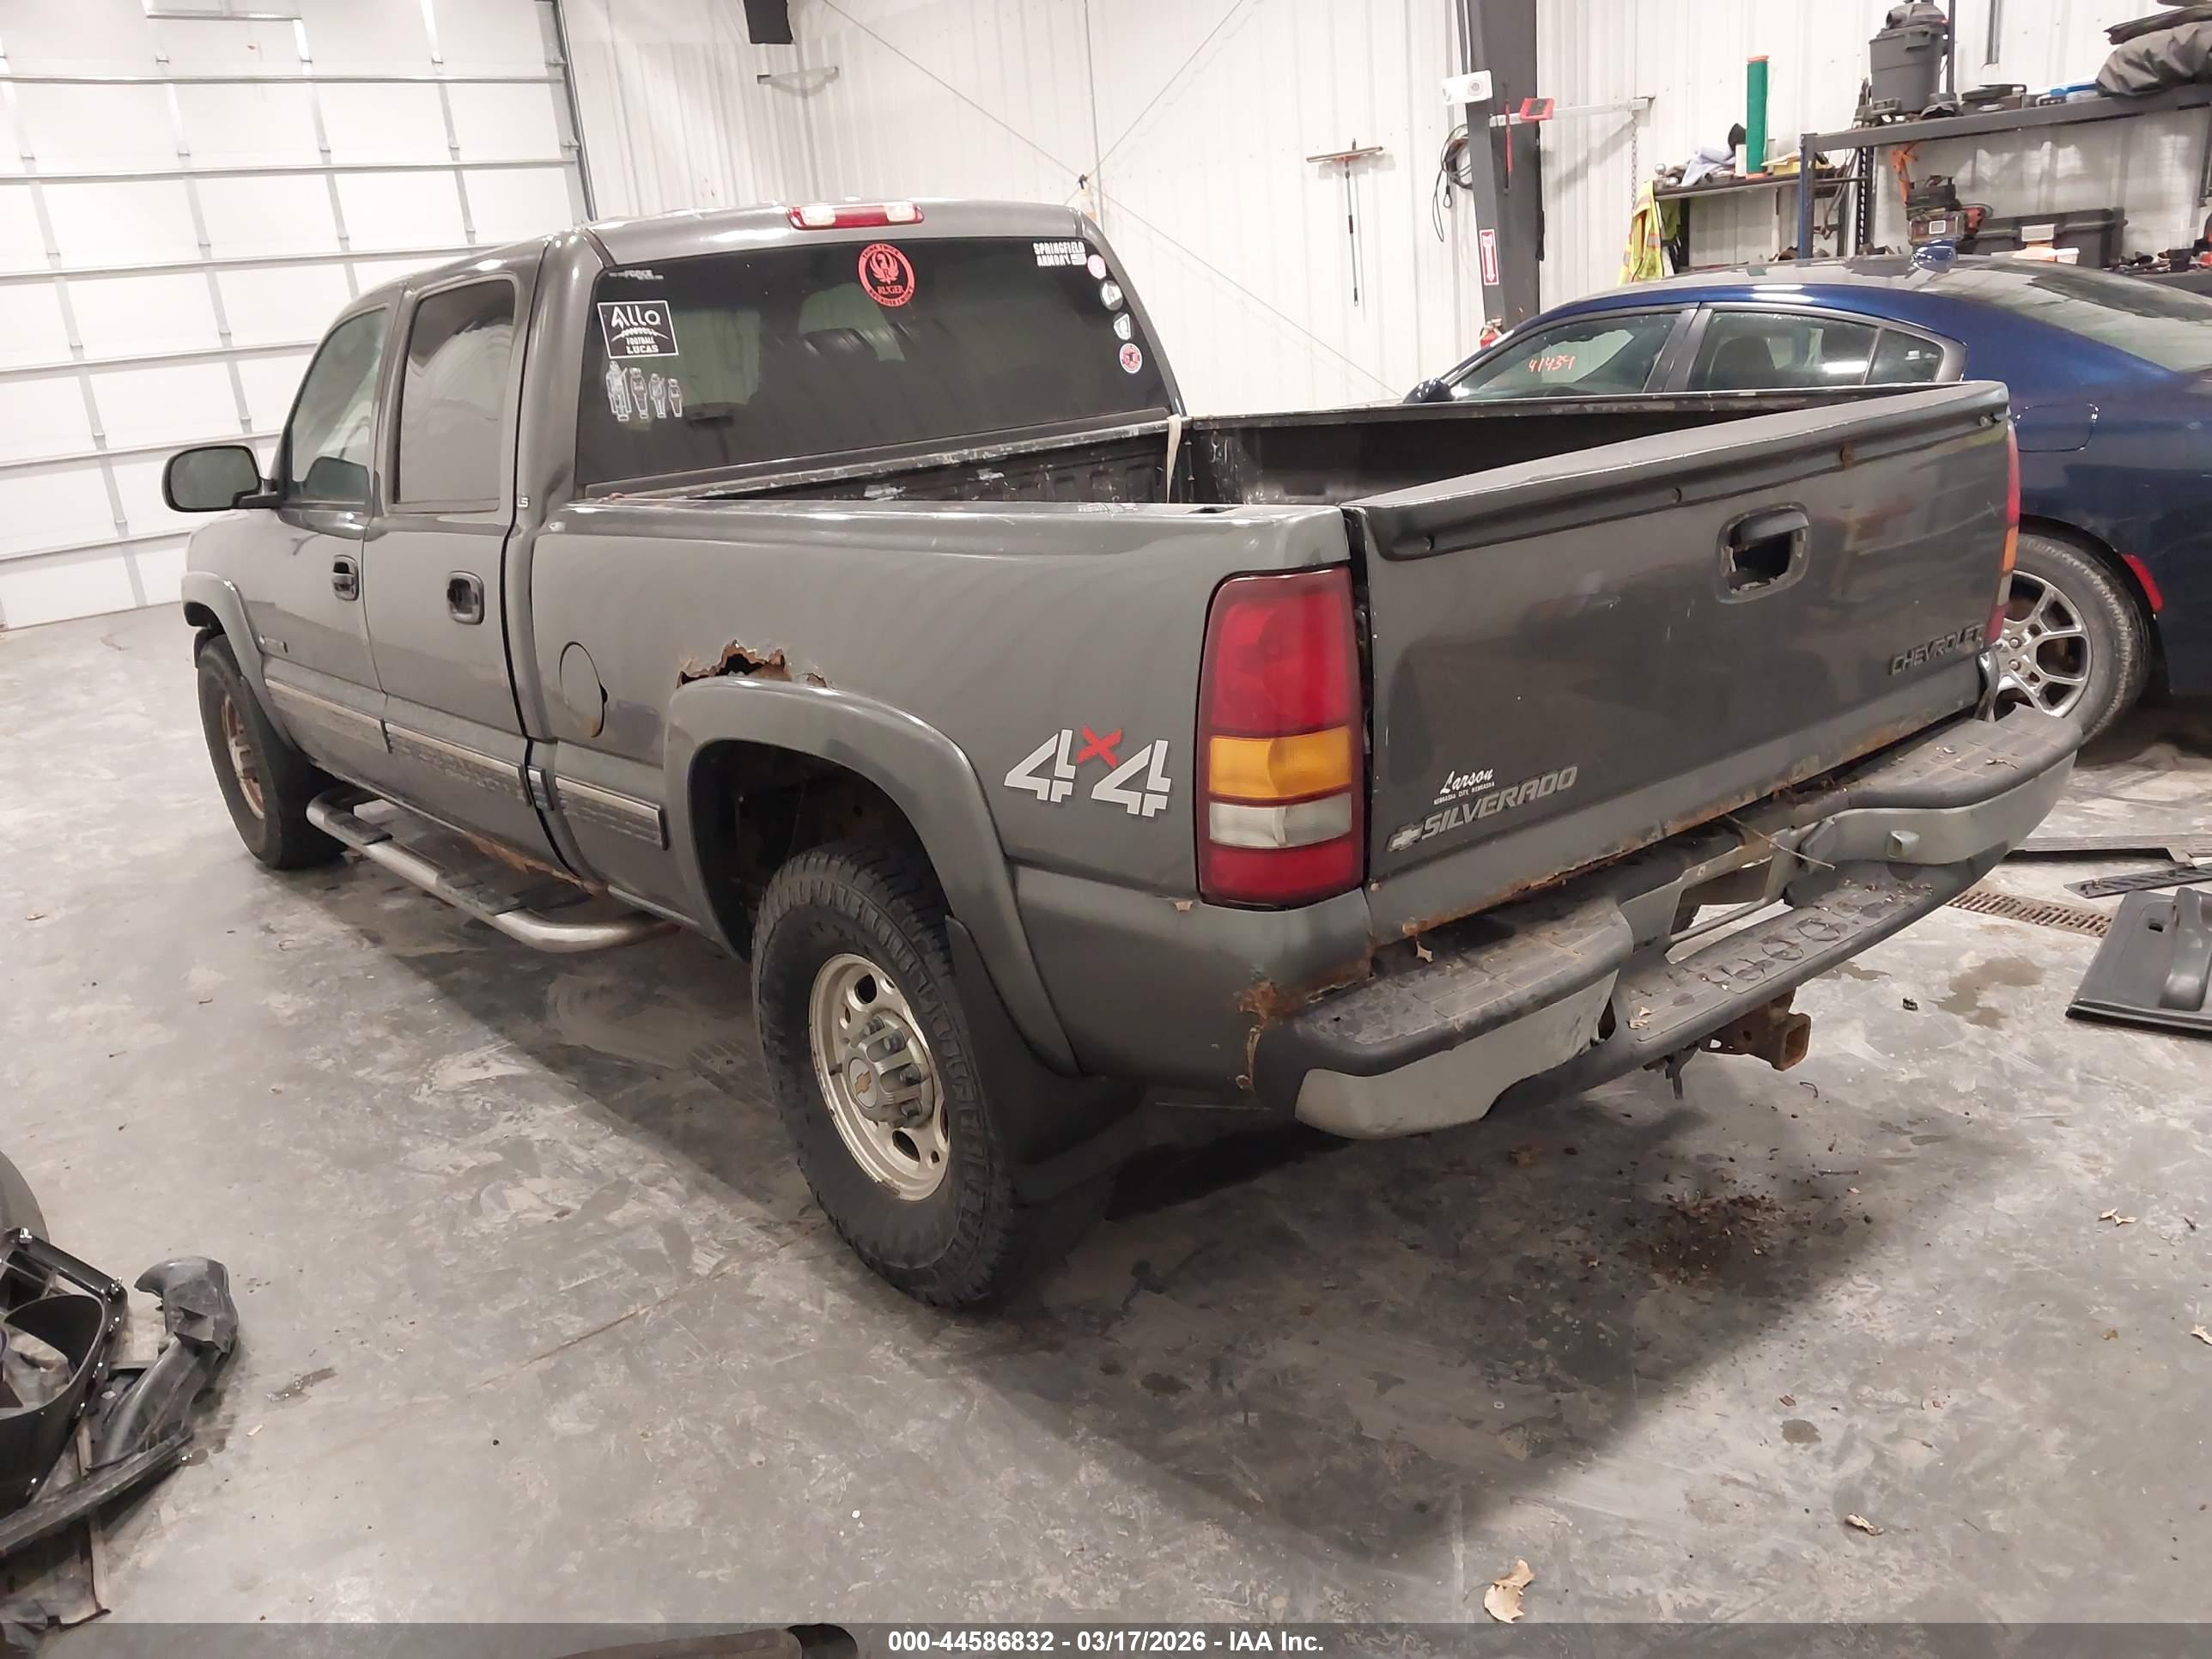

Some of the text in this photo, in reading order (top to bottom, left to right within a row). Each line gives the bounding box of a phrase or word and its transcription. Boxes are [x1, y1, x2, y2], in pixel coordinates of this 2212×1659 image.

[1033, 241, 1085, 255] SPRINGFIELD
[1036, 254, 1071, 266] ARMORY
[625, 345, 659, 355] LUCAS
[1889, 623, 1986, 675] CHEVROLET
[1439, 768, 1494, 795] Larson
[1420, 766, 1578, 841] SILVERADO
